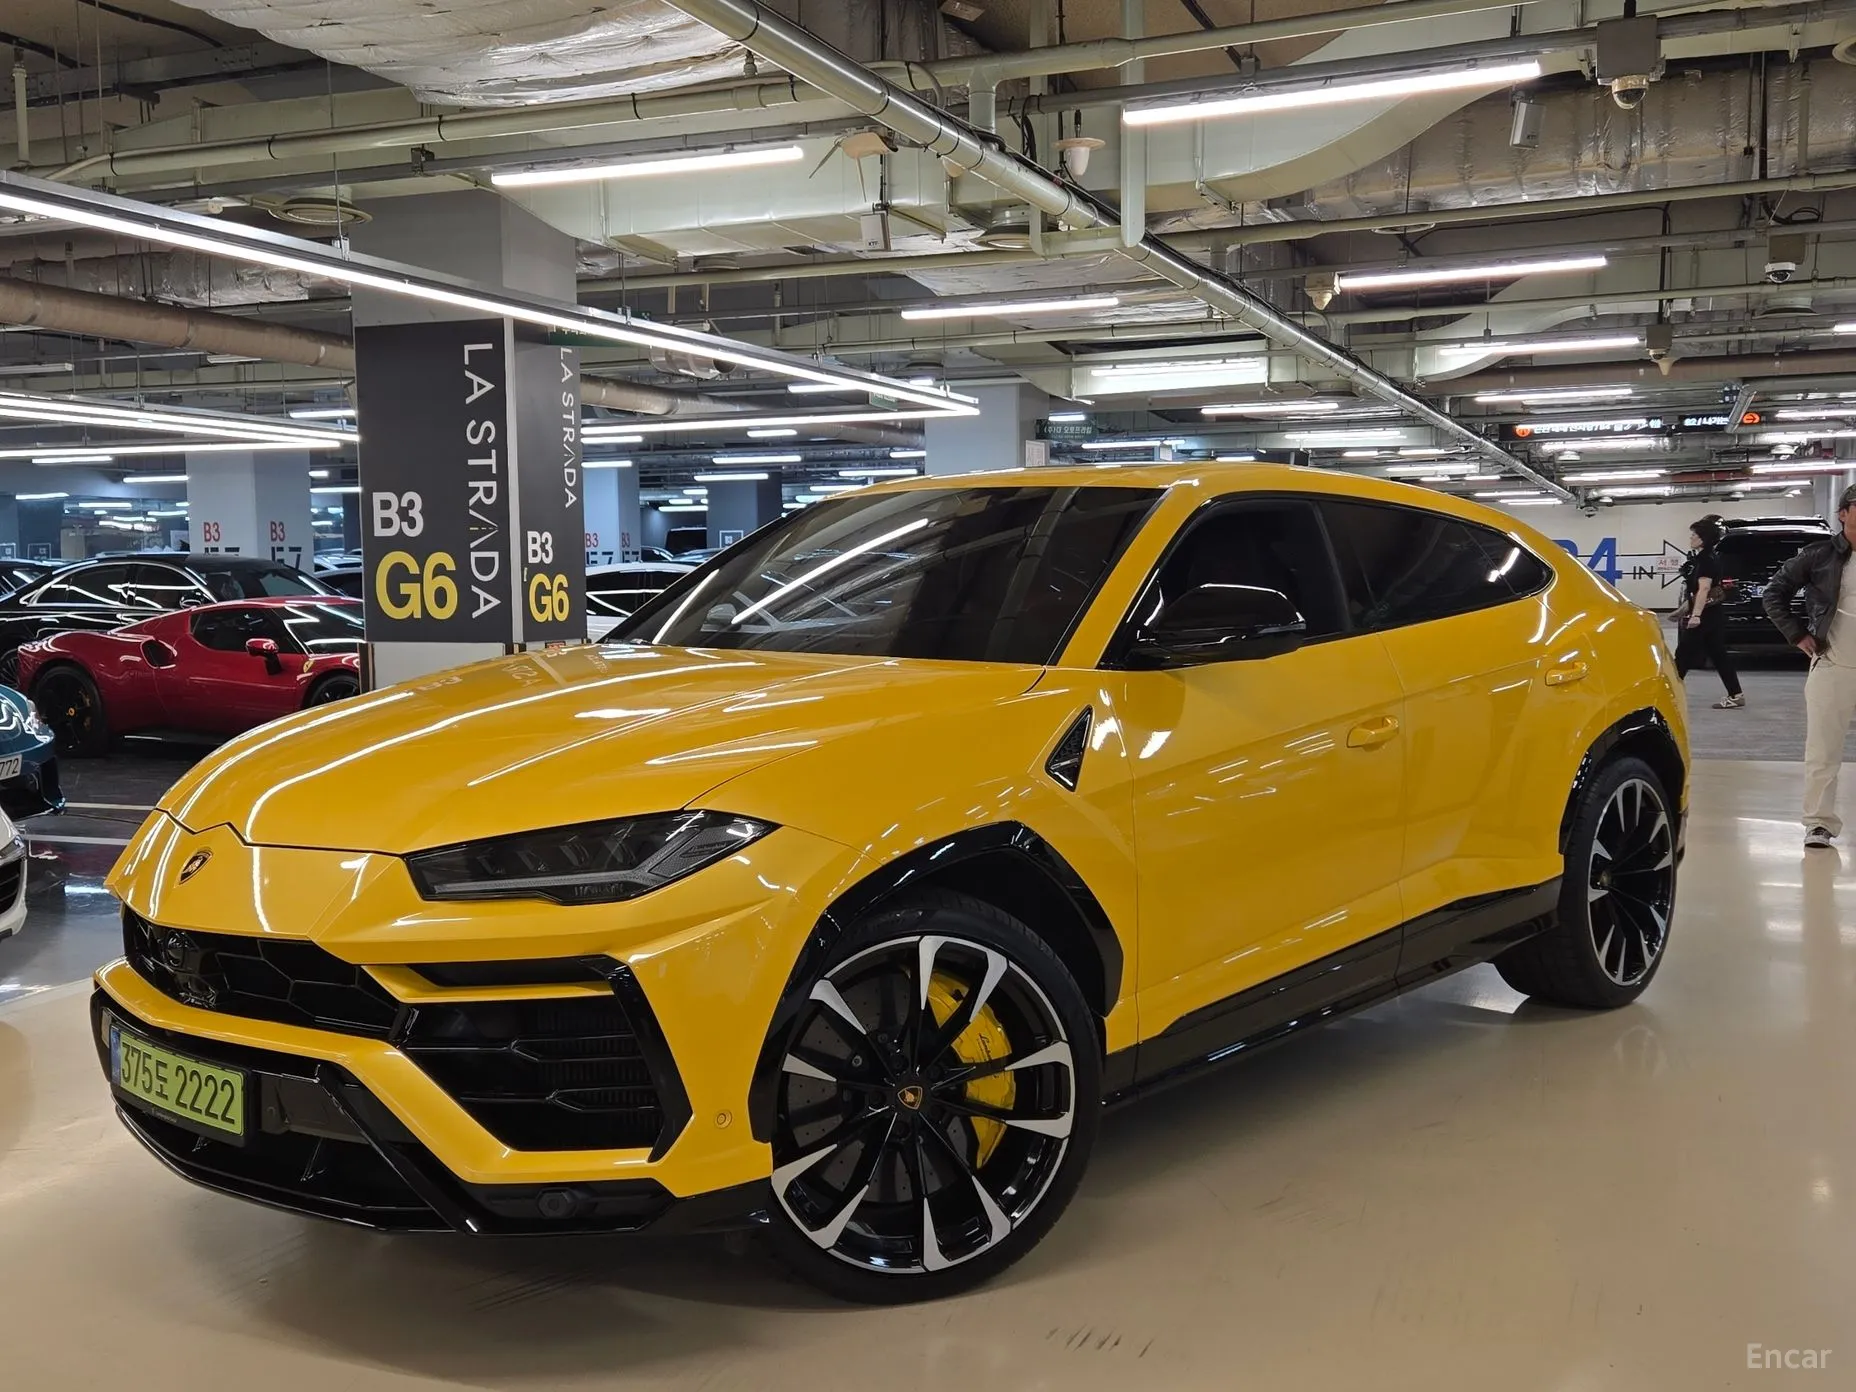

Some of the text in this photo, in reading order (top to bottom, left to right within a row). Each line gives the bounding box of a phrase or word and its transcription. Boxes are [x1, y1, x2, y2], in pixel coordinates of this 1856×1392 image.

[463, 343, 496, 404] LA
[560, 347, 573, 383] LA
[203, 522, 220, 542] B3
[270, 521, 285, 542] B3
[372, 491, 424, 537] B3
[527, 531, 553, 564] B3
[585, 533, 599, 548] B3
[375, 551, 458, 620] G6
[1633, 566, 1654, 580] IN
[529, 572, 570, 622] G6
[121, 1041, 236, 1125] 375도 2222
